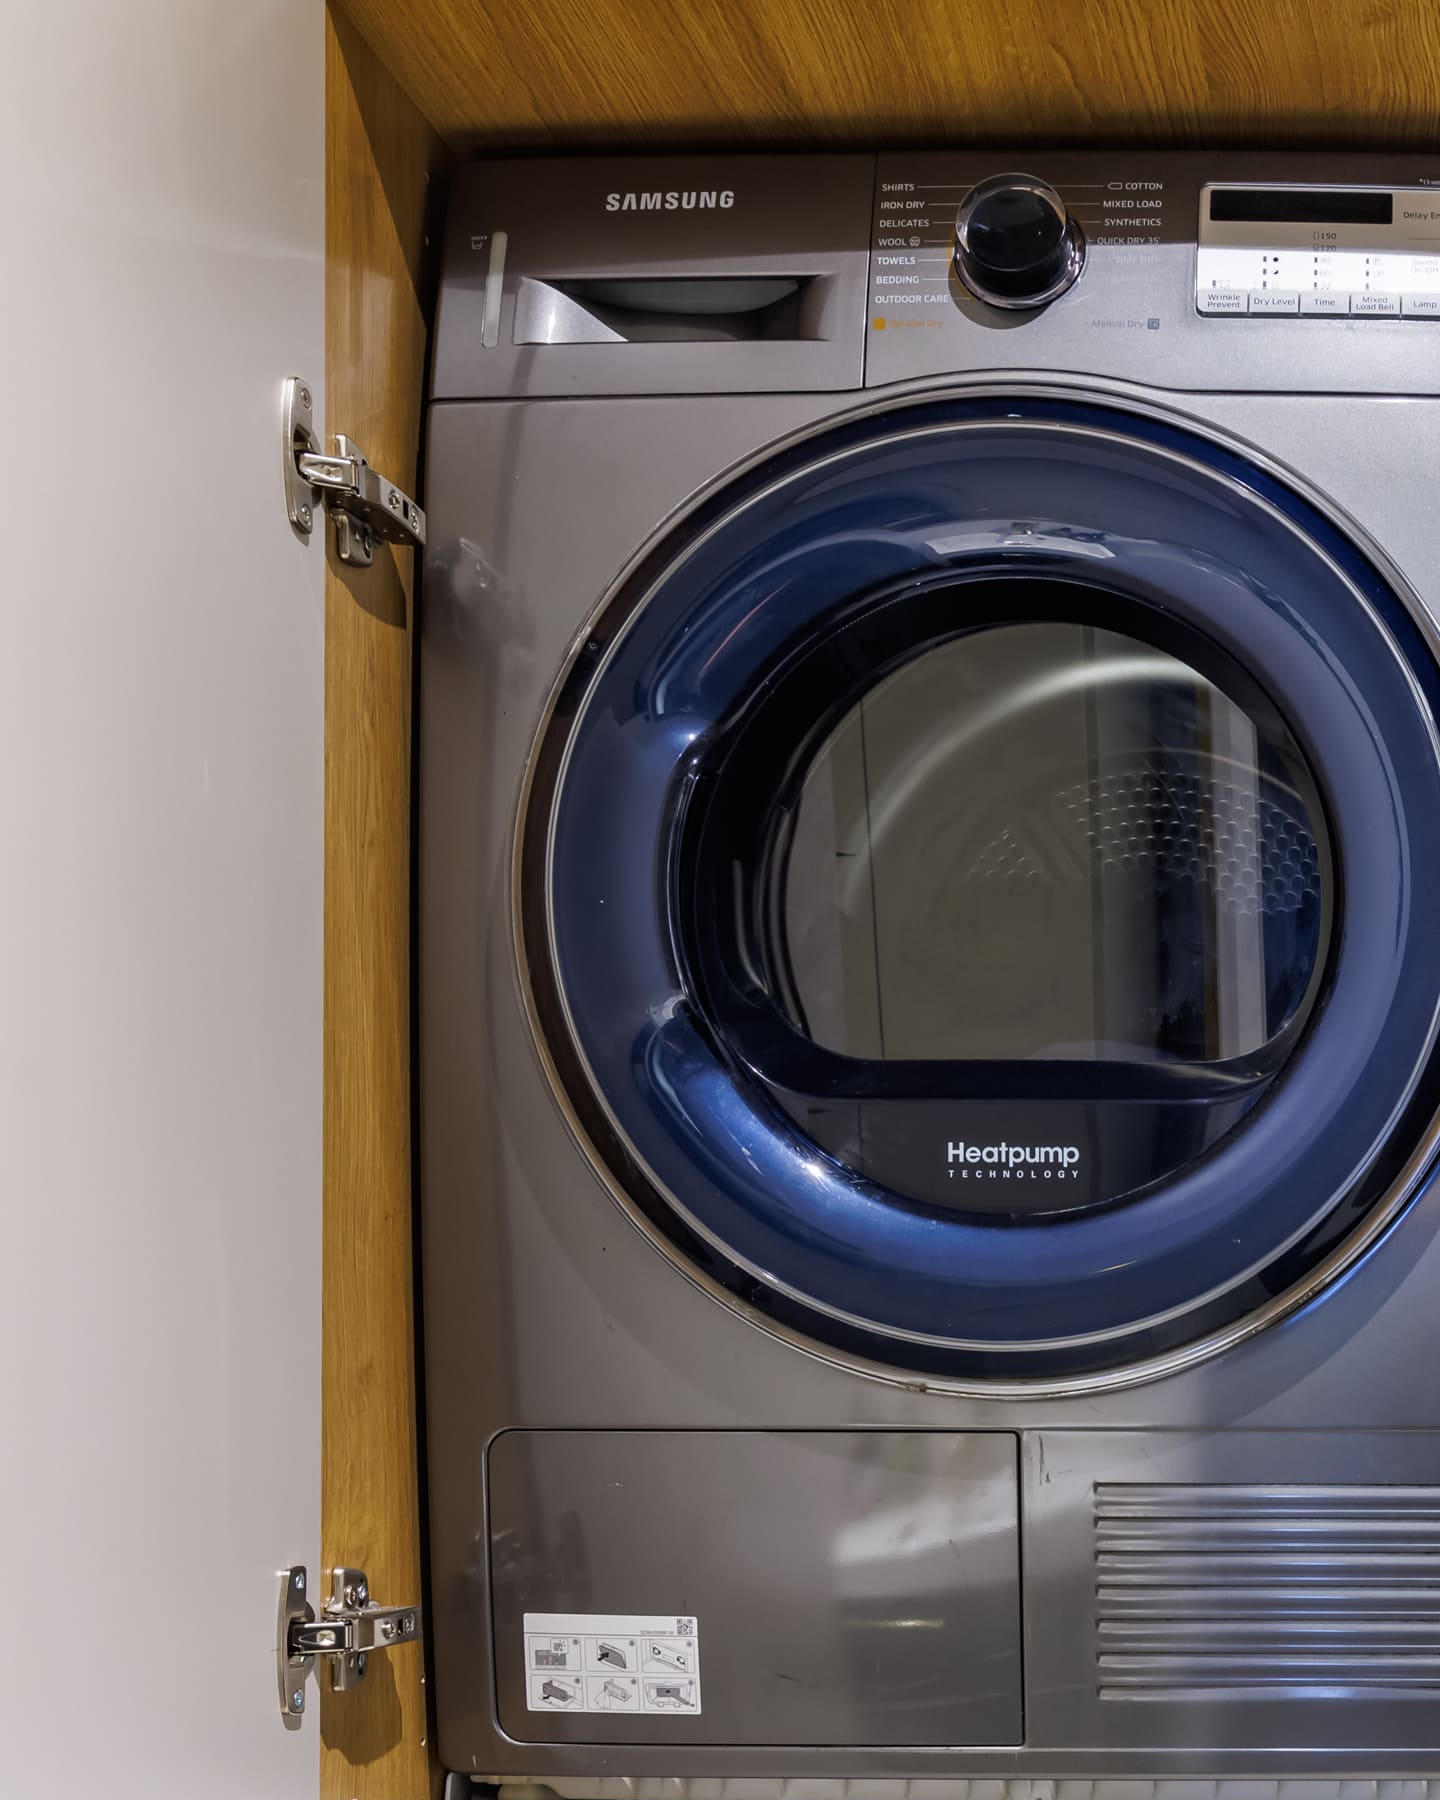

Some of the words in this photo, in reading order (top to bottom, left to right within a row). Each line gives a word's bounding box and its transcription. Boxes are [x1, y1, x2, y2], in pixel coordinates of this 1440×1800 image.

[882, 183, 915, 192] SHIRTS
[1125, 182, 1163, 190] COTTON
[605, 190, 735, 212] SAMSUNG
[880, 201, 904, 210] IRON
[906, 200, 926, 209] DRY
[1103, 200, 1134, 208] MIXED
[1136, 200, 1162, 208] LOAD
[1403, 211, 1428, 220] Delay
[880, 219, 930, 228] DELICATES
[1104, 218, 1162, 226] SYNTHETICS
[1097, 236, 1125, 245] QUICK
[1127, 236, 1146, 245] DRY
[1320, 232, 1337, 240] 150
[878, 238, 907, 246] WOOL
[1320, 244, 1337, 252] 120
[876, 256, 916, 265] TOWELS
[876, 276, 920, 284] BEDDING
[874, 294, 922, 304] OUTDOOR
[924, 294, 949, 303] CARE
[1254, 297, 1270, 306] Dry
[1272, 297, 1296, 306] Level
[1314, 298, 1336, 306] Time
[1362, 296, 1388, 304] Mixed
[1208, 301, 1240, 309] Prevent
[1412, 300, 1438, 310] Lamp
[1092, 319, 1124, 328] Manual
[1128, 320, 1145, 330] Dry
[947, 1142, 1080, 1168] Heatpump
[948, 1170, 1078, 1178] TECHNOLOGY
